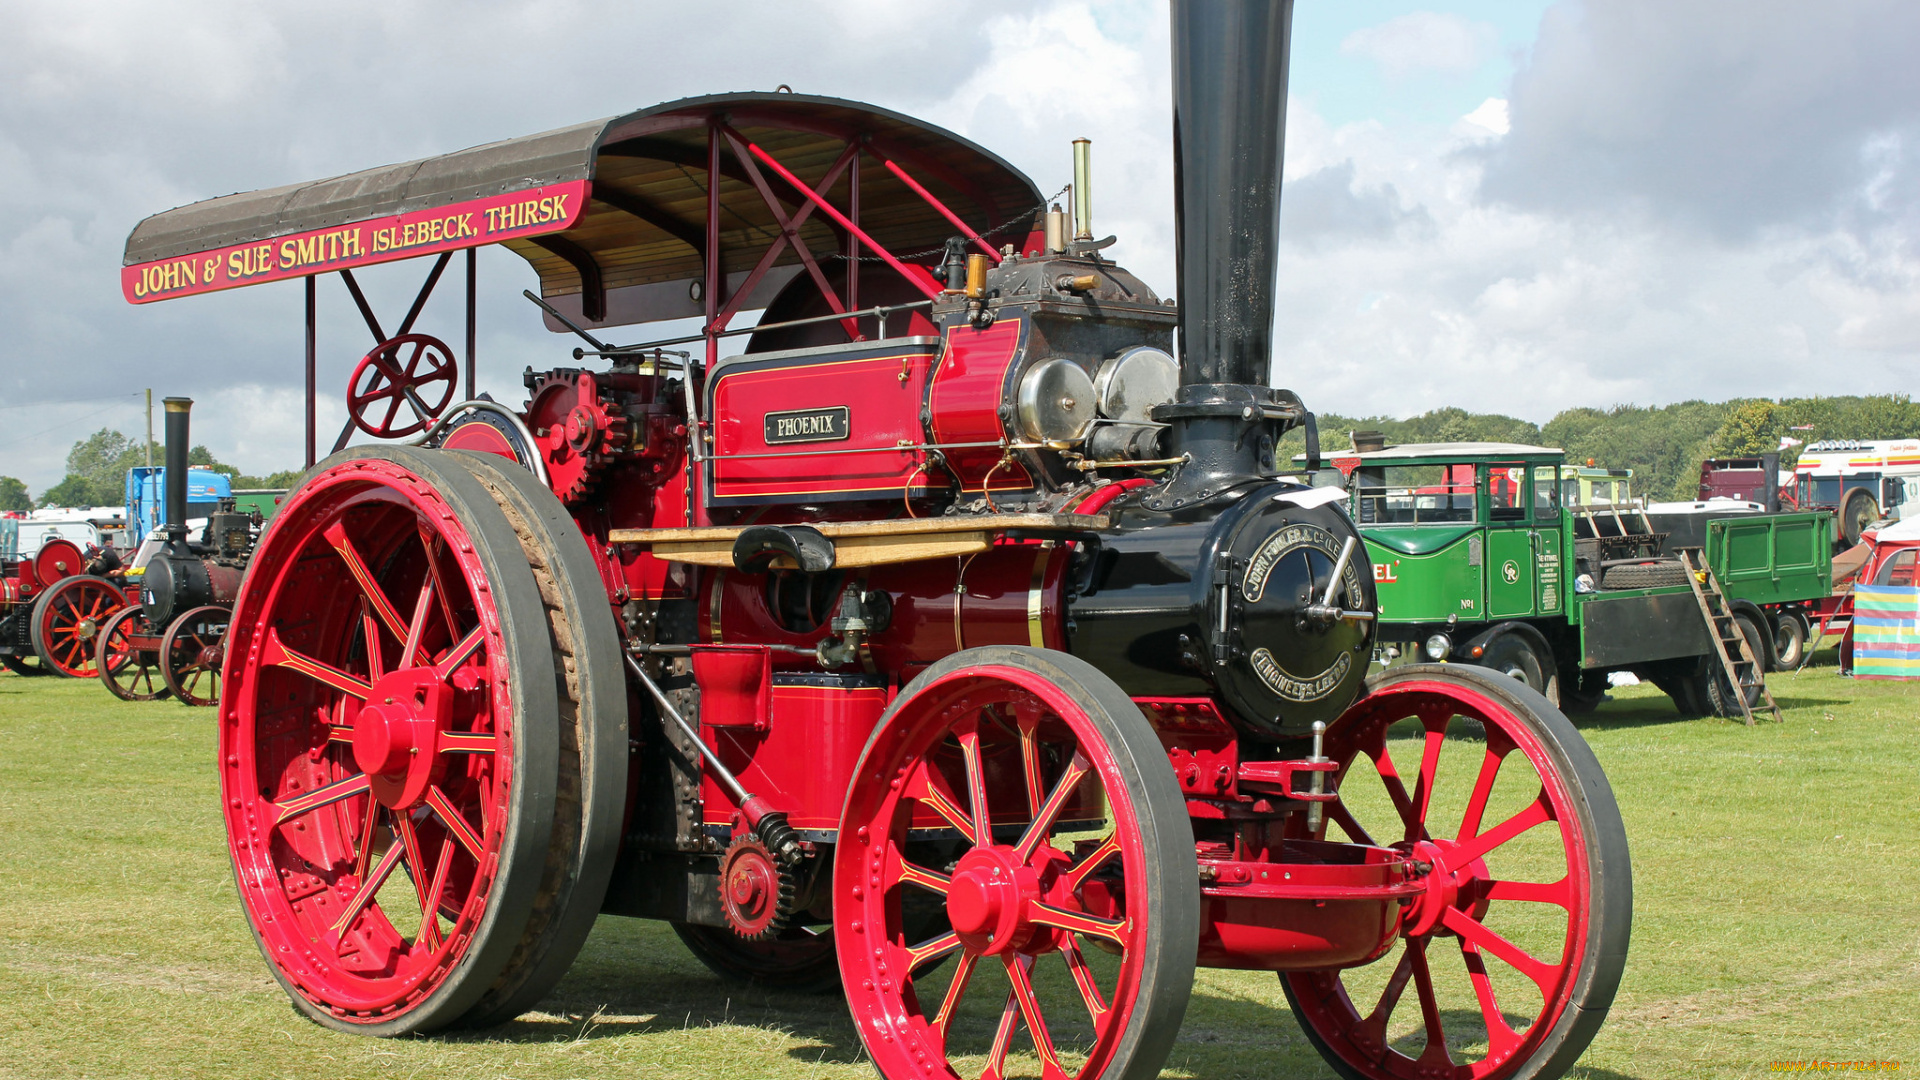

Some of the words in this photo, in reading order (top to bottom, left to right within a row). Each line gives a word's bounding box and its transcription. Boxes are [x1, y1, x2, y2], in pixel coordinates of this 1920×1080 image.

[134, 258, 197, 297] JOHN
[203, 254, 222, 283] &
[228, 244, 272, 278] SUE
[279, 228, 366, 269] SMITH,
[372, 212, 478, 252] ISLEBECK,
[485, 193, 569, 232] THIRSK
[777, 414, 835, 437] PHOENIX
[1248, 555, 1269, 592] JOHN
